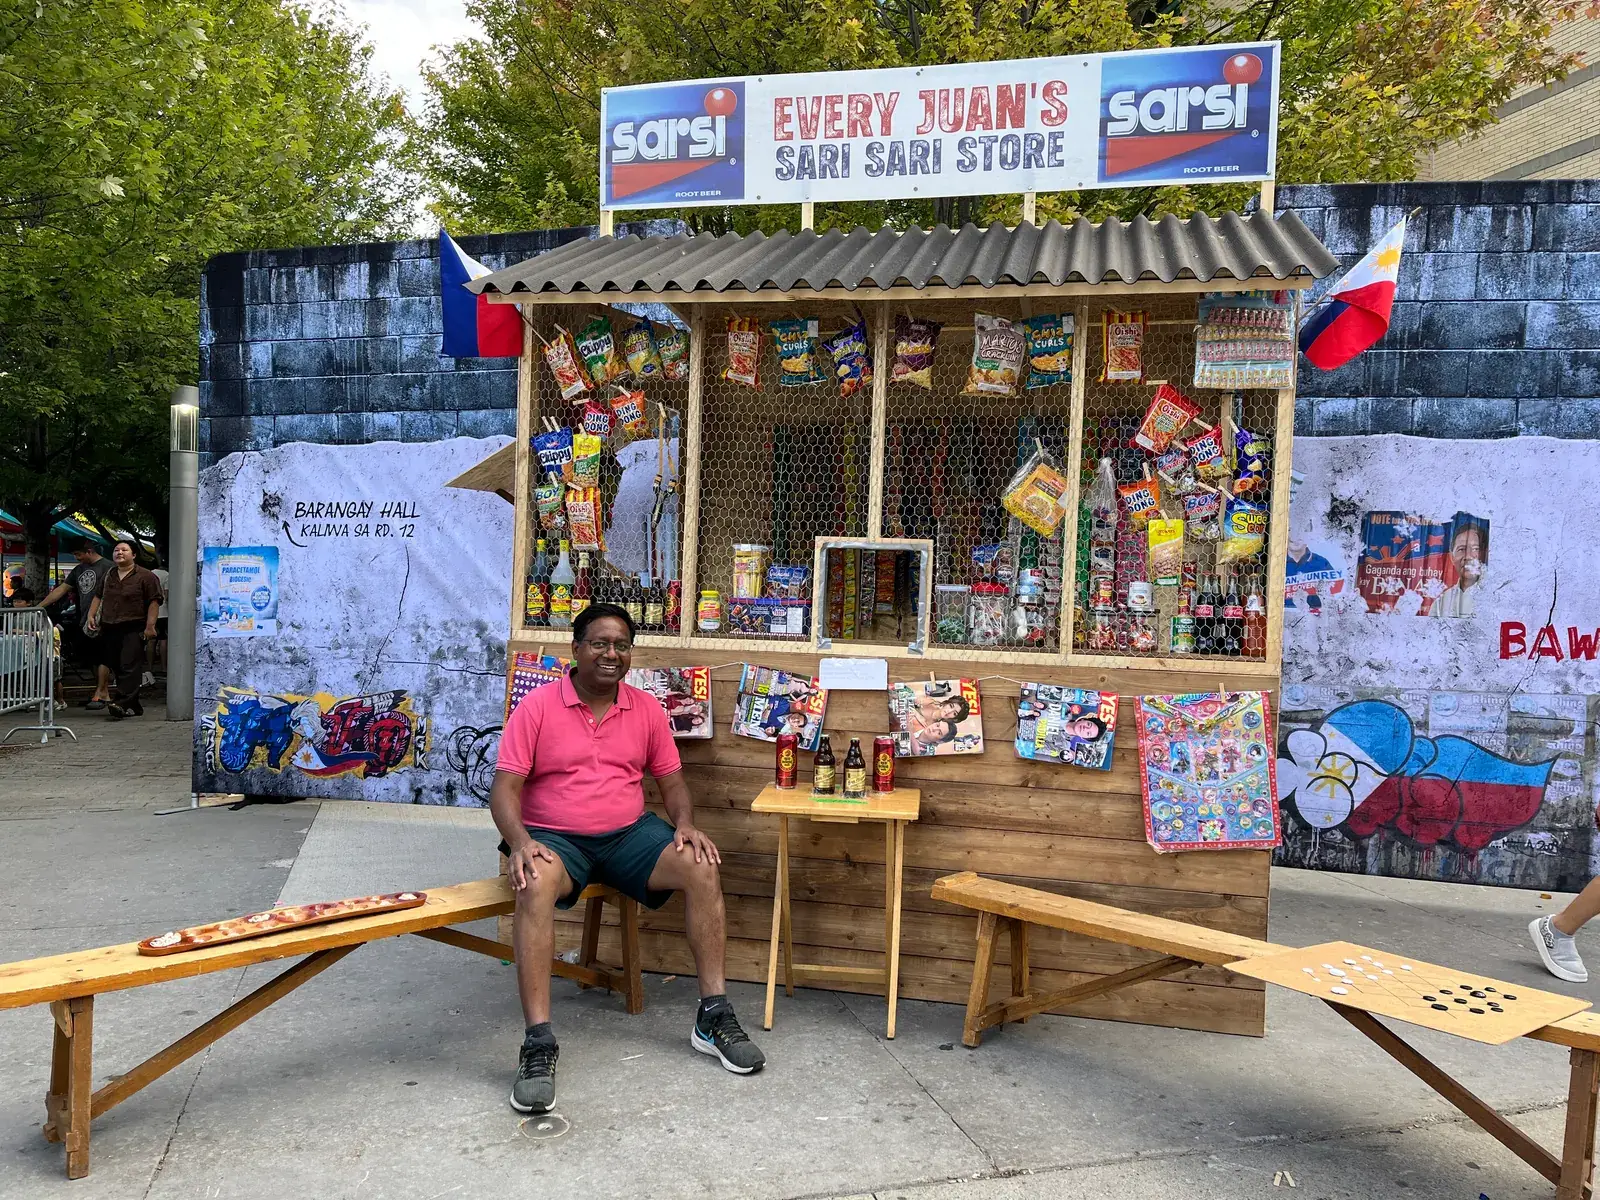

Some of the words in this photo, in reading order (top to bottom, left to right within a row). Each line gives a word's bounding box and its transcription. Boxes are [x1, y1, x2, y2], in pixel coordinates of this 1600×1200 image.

[774, 92, 900, 141] EVERY
[916, 80, 1068, 135] JUAN'S
[1107, 83, 1249, 136] sarsi
[612, 115, 726, 163] sarsi
[775, 143, 850, 180] SARI
[865, 138, 942, 177] SARI
[956, 131, 1065, 172] STORE
[1184, 166, 1212, 174] ROOT
[1214, 165, 1240, 173] BEER
[675, 190, 699, 198] ROOT
[782, 341, 809, 351] CURLS
[1035, 338, 1065, 349] CURLS
[615, 403, 637, 417] DING
[1162, 404, 1181, 420] Oishi
[587, 413, 609, 424] DING
[585, 422, 609, 433] DONG
[536, 486, 560, 500] BOY
[1124, 489, 1150, 505] DING
[1128, 498, 1155, 513] DONG
[1186, 491, 1219, 510] BOY
[294, 501, 374, 518] BARANGAY
[380, 501, 421, 518] HALL
[1370, 513, 1391, 525] VOTE
[300, 523, 349, 537] KALIWA
[354, 523, 370, 537] SA
[374, 524, 394, 537] RD.
[399, 523, 415, 537] 12
[1304, 570, 1343, 581] UNREY
[1365, 564, 1401, 577] Gaganda
[1402, 567, 1416, 578] ang
[1419, 566, 1443, 578] buhay
[694, 667, 708, 700] YES!
[1472, 695, 1505, 704] Rhino
[1551, 697, 1584, 707] Rhino
[1099, 695, 1117, 729] YES!
